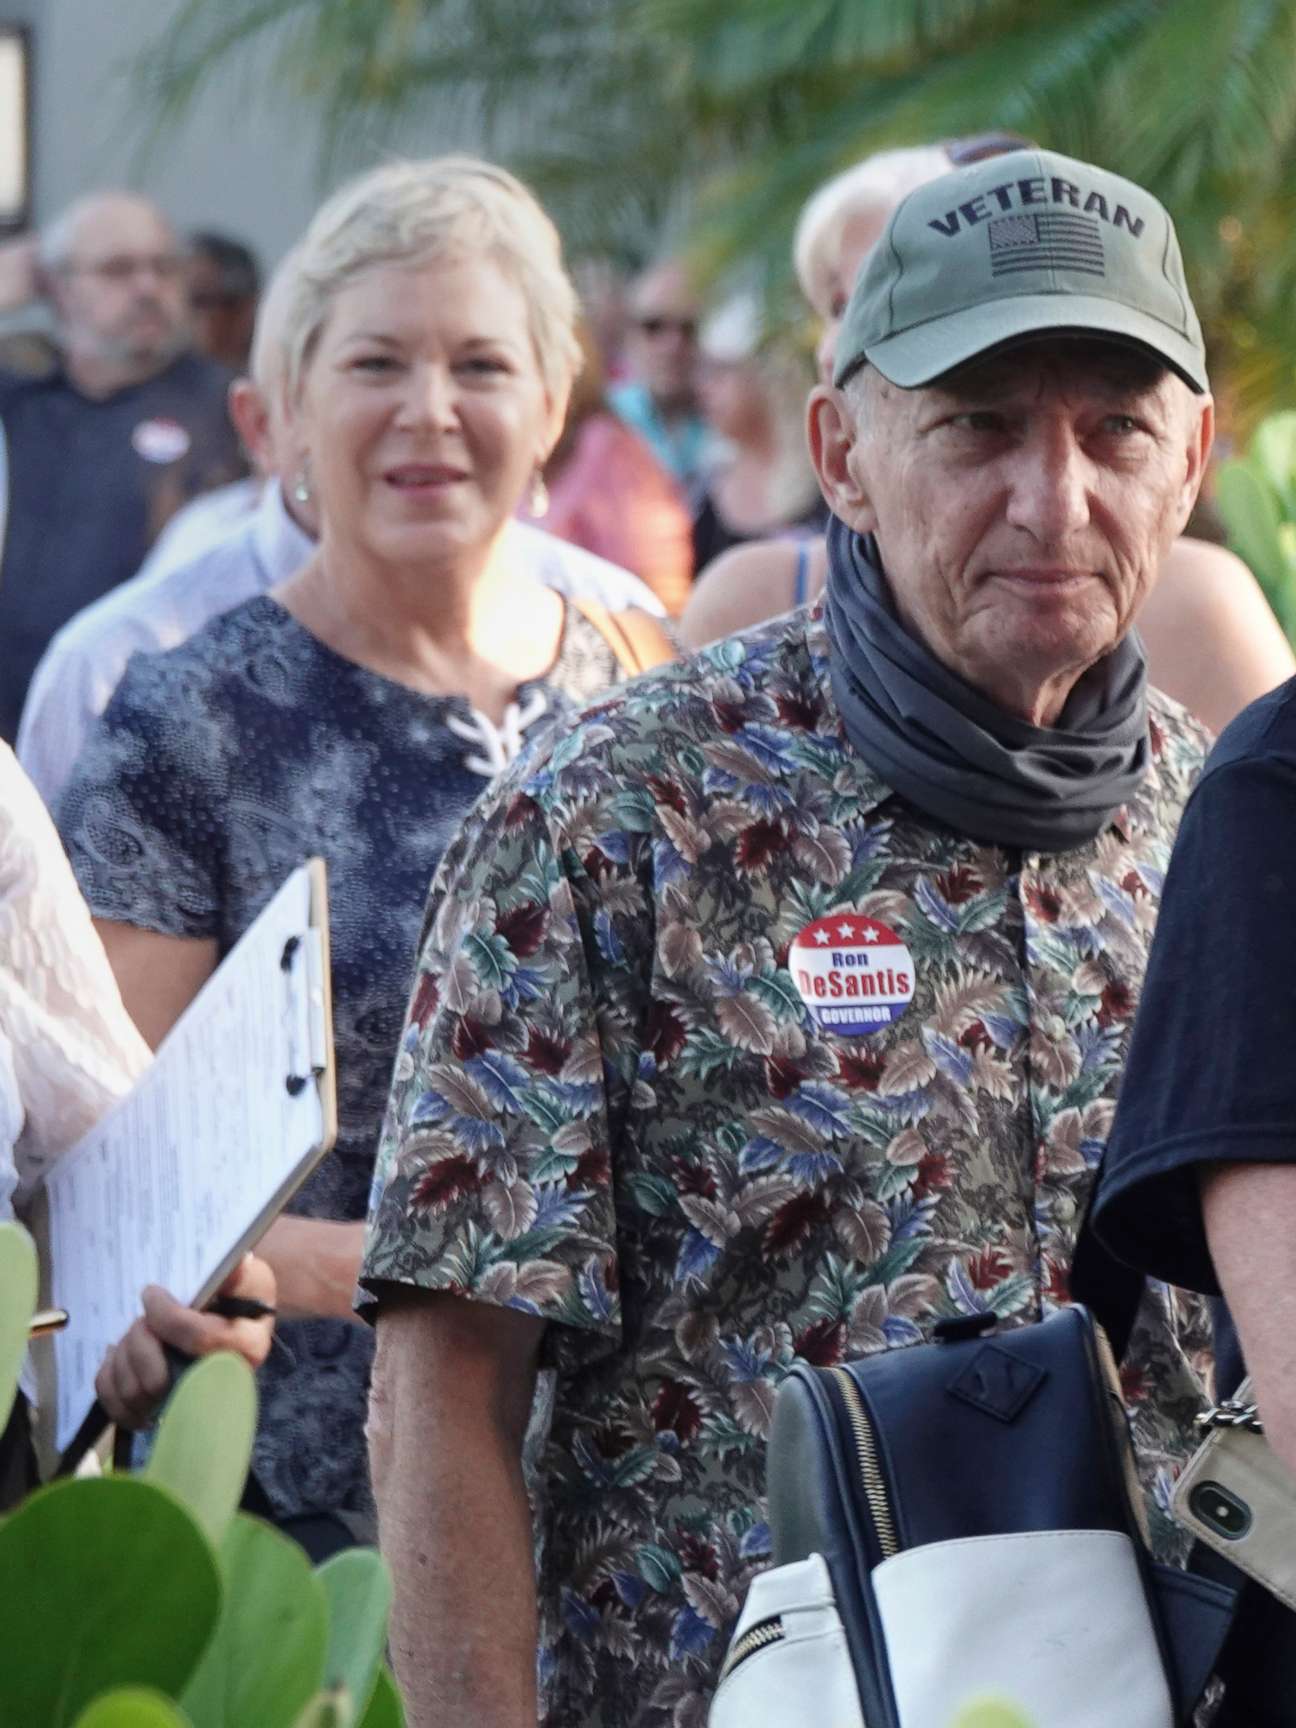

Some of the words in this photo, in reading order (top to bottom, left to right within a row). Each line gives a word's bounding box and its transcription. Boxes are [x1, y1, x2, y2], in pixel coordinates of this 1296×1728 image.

[928, 177, 1145, 238] VETERAN
[831, 952, 869, 967] Ron
[798, 968, 910, 998] DeSantis
[820, 1005, 892, 1025] GOVERNOR
